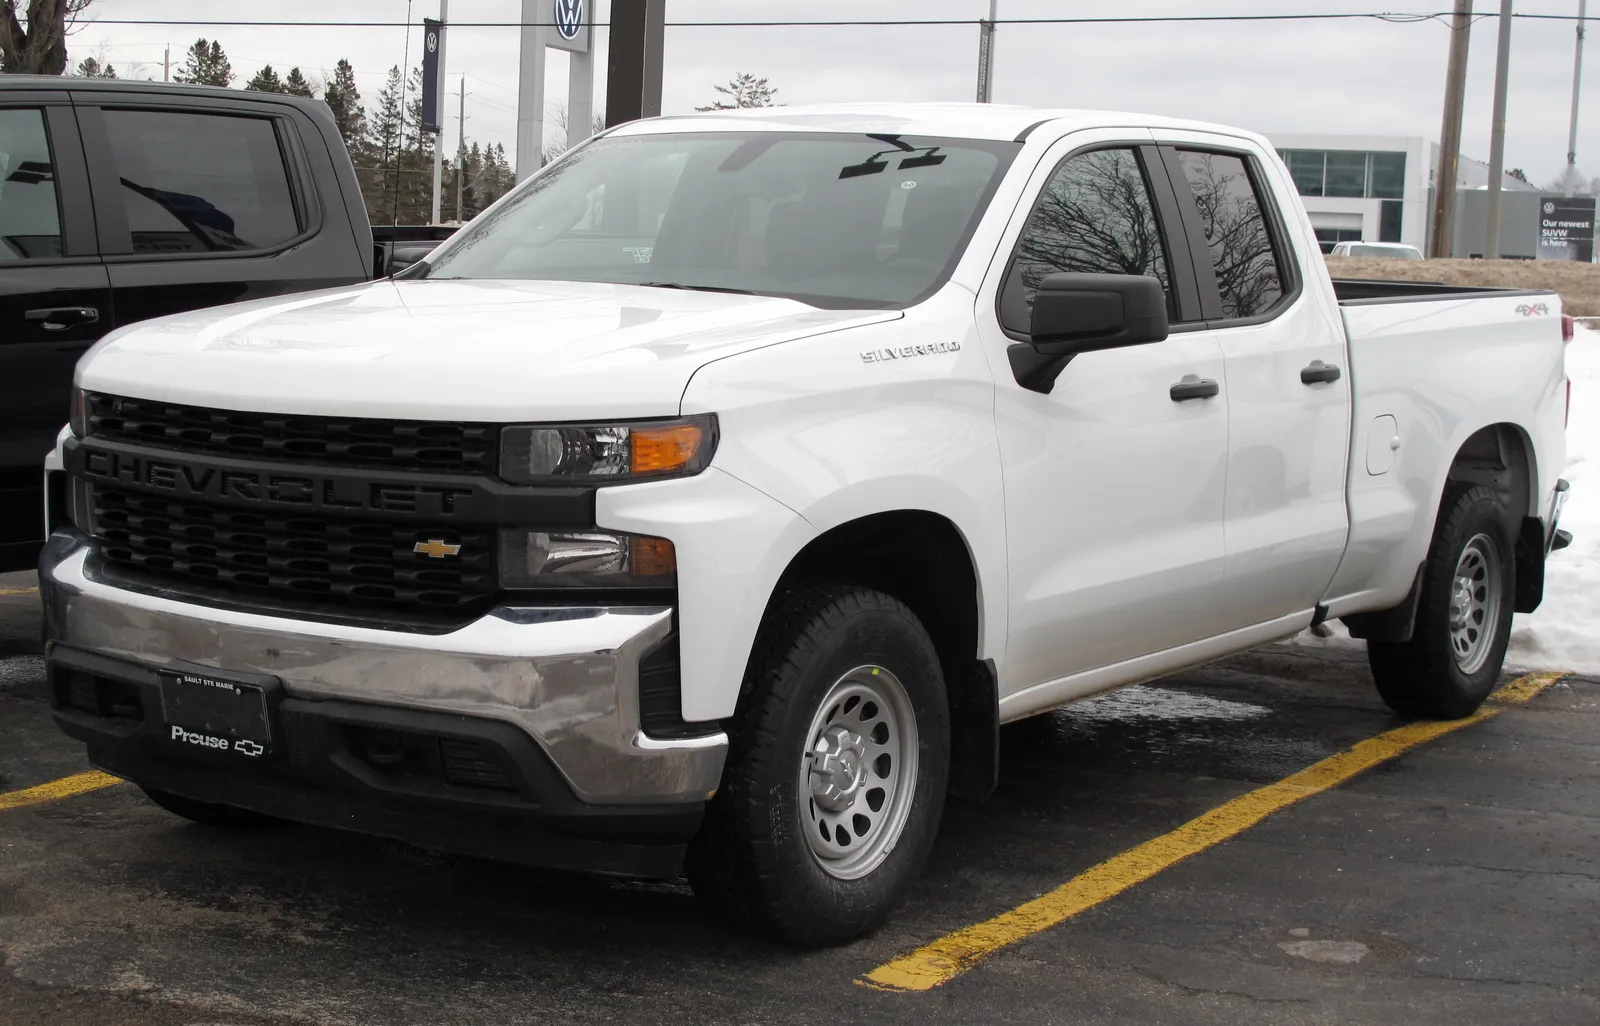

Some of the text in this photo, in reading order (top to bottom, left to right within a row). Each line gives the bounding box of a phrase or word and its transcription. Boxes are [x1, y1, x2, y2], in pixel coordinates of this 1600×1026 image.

[1542, 219, 1590, 228] Our newest
[1541, 229, 1568, 237] SUVW
[1541, 238, 1568, 247] is here
[860, 341, 961, 363] SILVERADO
[84, 448, 473, 516] CHEVROLET
[184, 676, 234, 691] SAULT STE MARIE
[171, 725, 229, 750] Prouse
